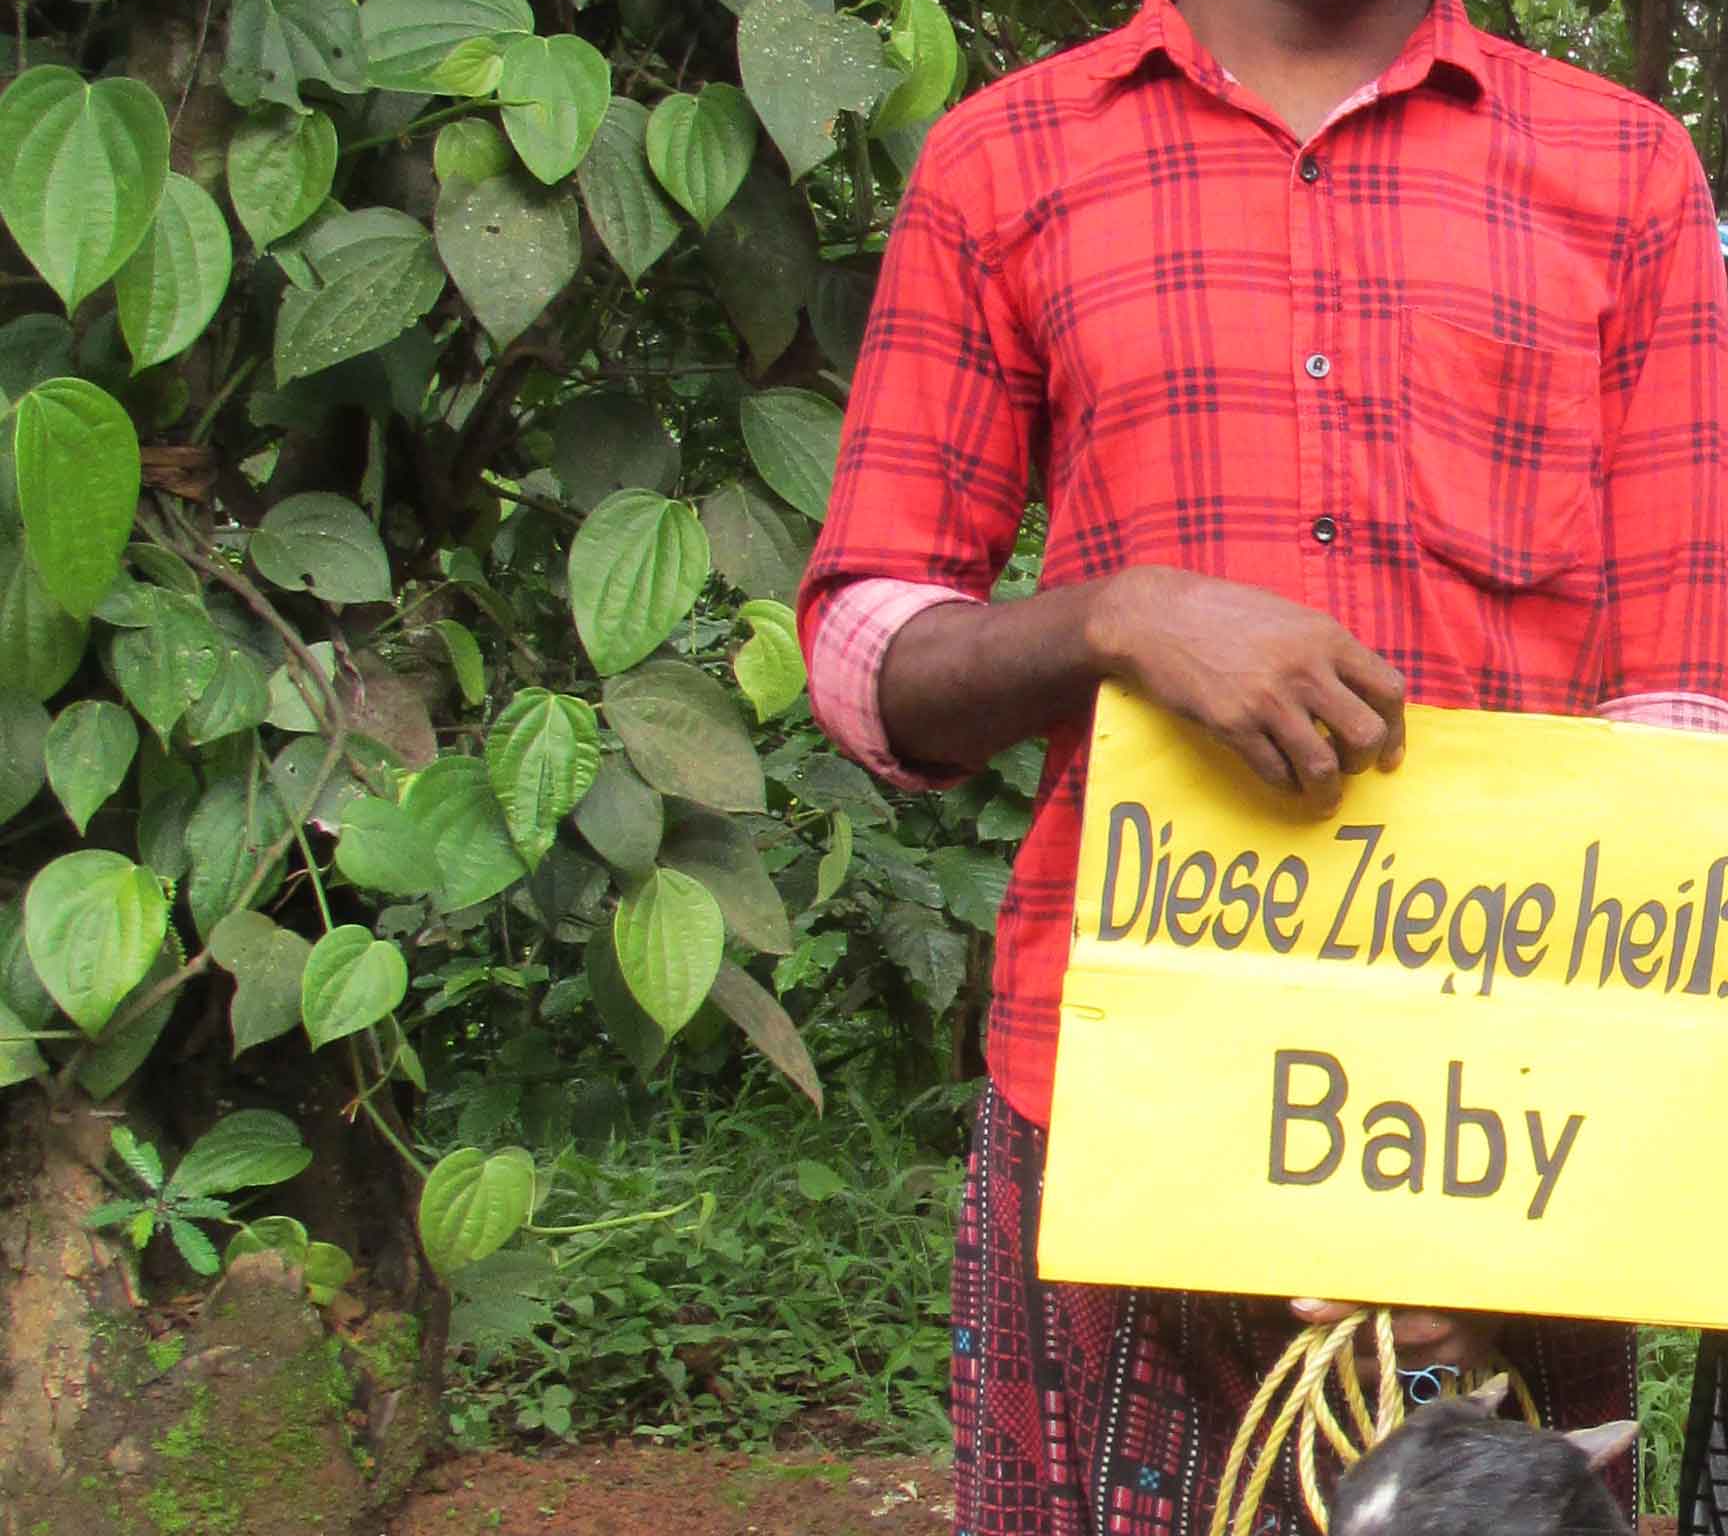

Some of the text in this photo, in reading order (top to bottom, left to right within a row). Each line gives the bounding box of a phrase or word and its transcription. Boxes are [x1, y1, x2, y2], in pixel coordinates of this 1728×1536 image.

[1097, 801, 1309, 953] Diese
[1318, 824, 1553, 996] Ziege
[1267, 1048, 1586, 1221] Baby
